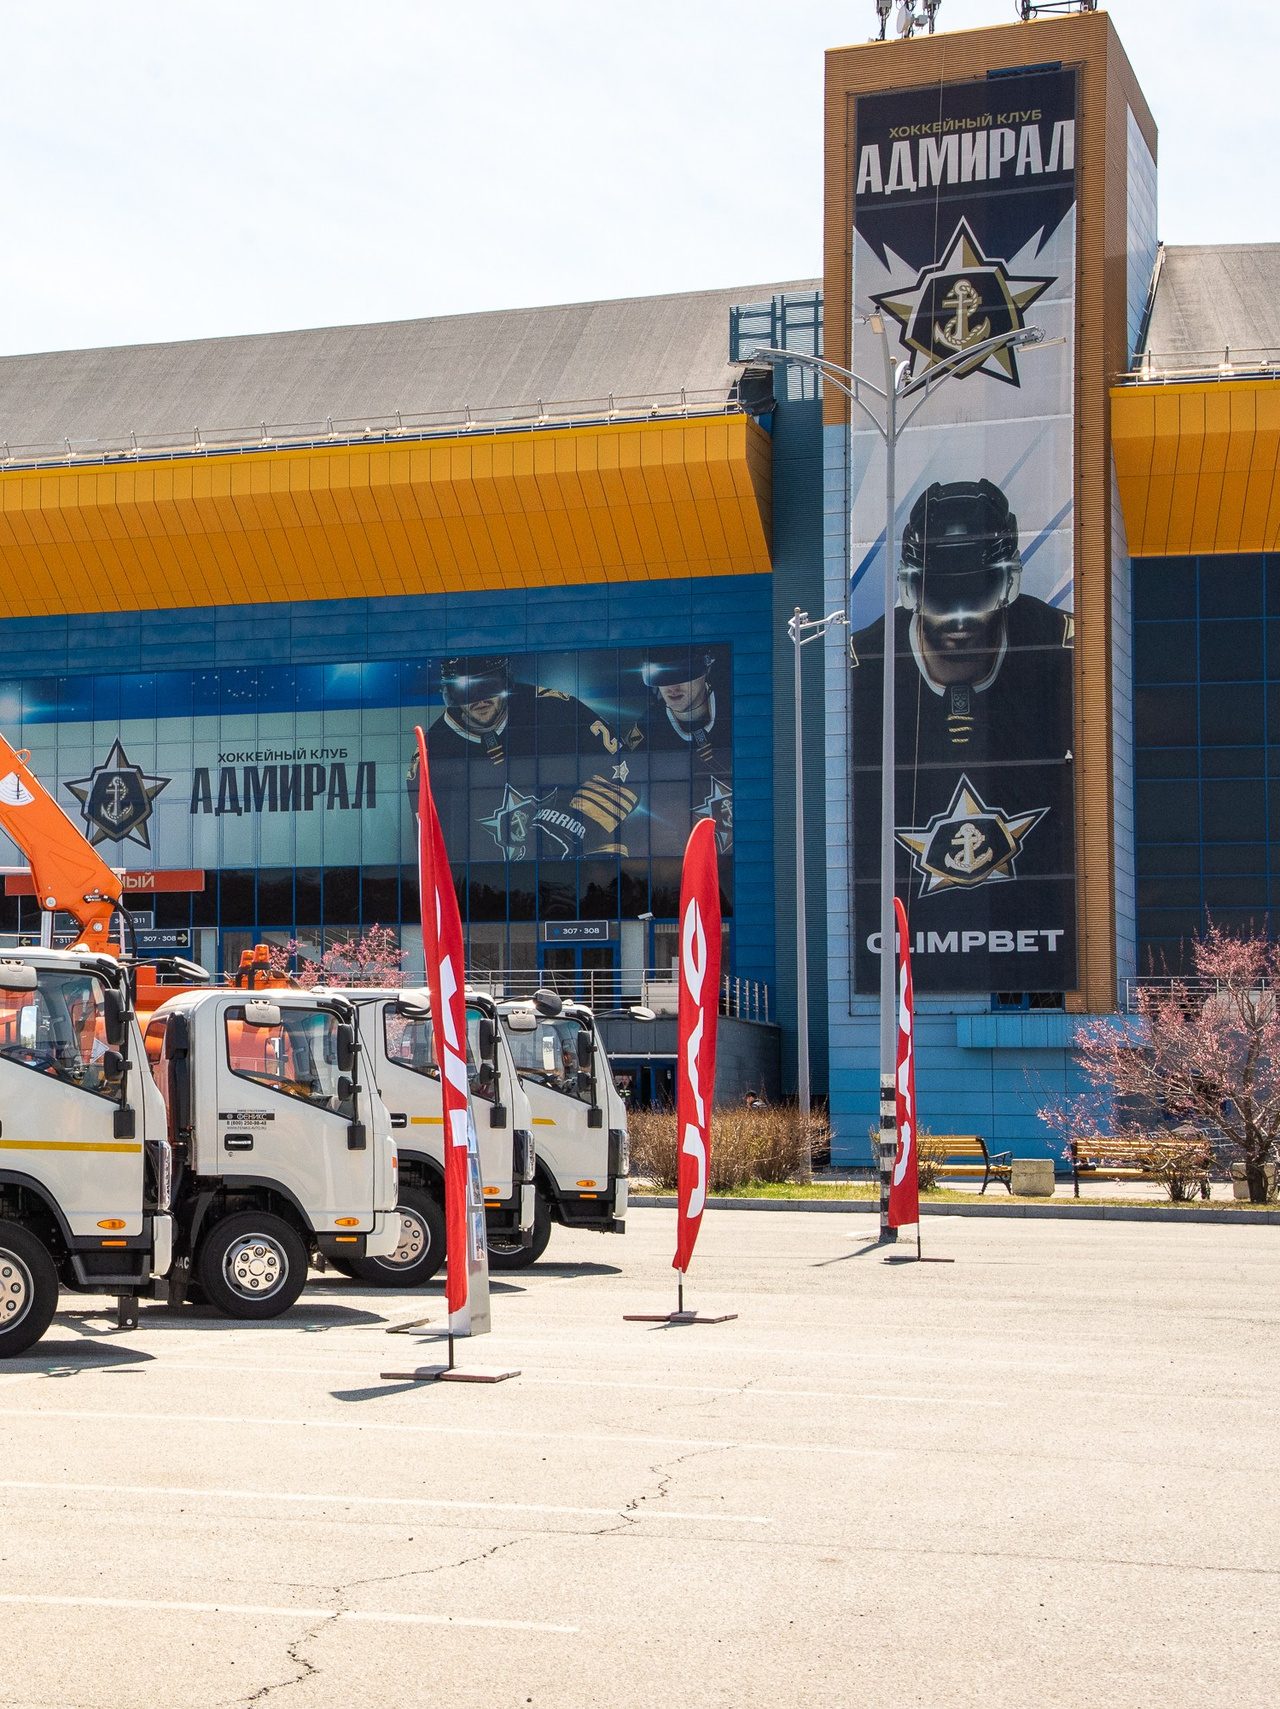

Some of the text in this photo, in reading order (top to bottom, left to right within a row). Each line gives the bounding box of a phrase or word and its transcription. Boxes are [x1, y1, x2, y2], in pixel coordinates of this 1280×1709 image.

[888, 109, 1042, 139] ХОККЕЙНЫЙ КЛУБ
[856, 119, 1075, 195] АДМИРАЛ
[217, 747, 349, 763] ХОККЕЙНЫЙ КЛУБ
[190, 761, 377, 817] АДМИРАЛ
[143, 935, 177, 943] 307 308
[562, 927, 600, 935] 307 308
[175, 1256, 190, 1269] JAC
